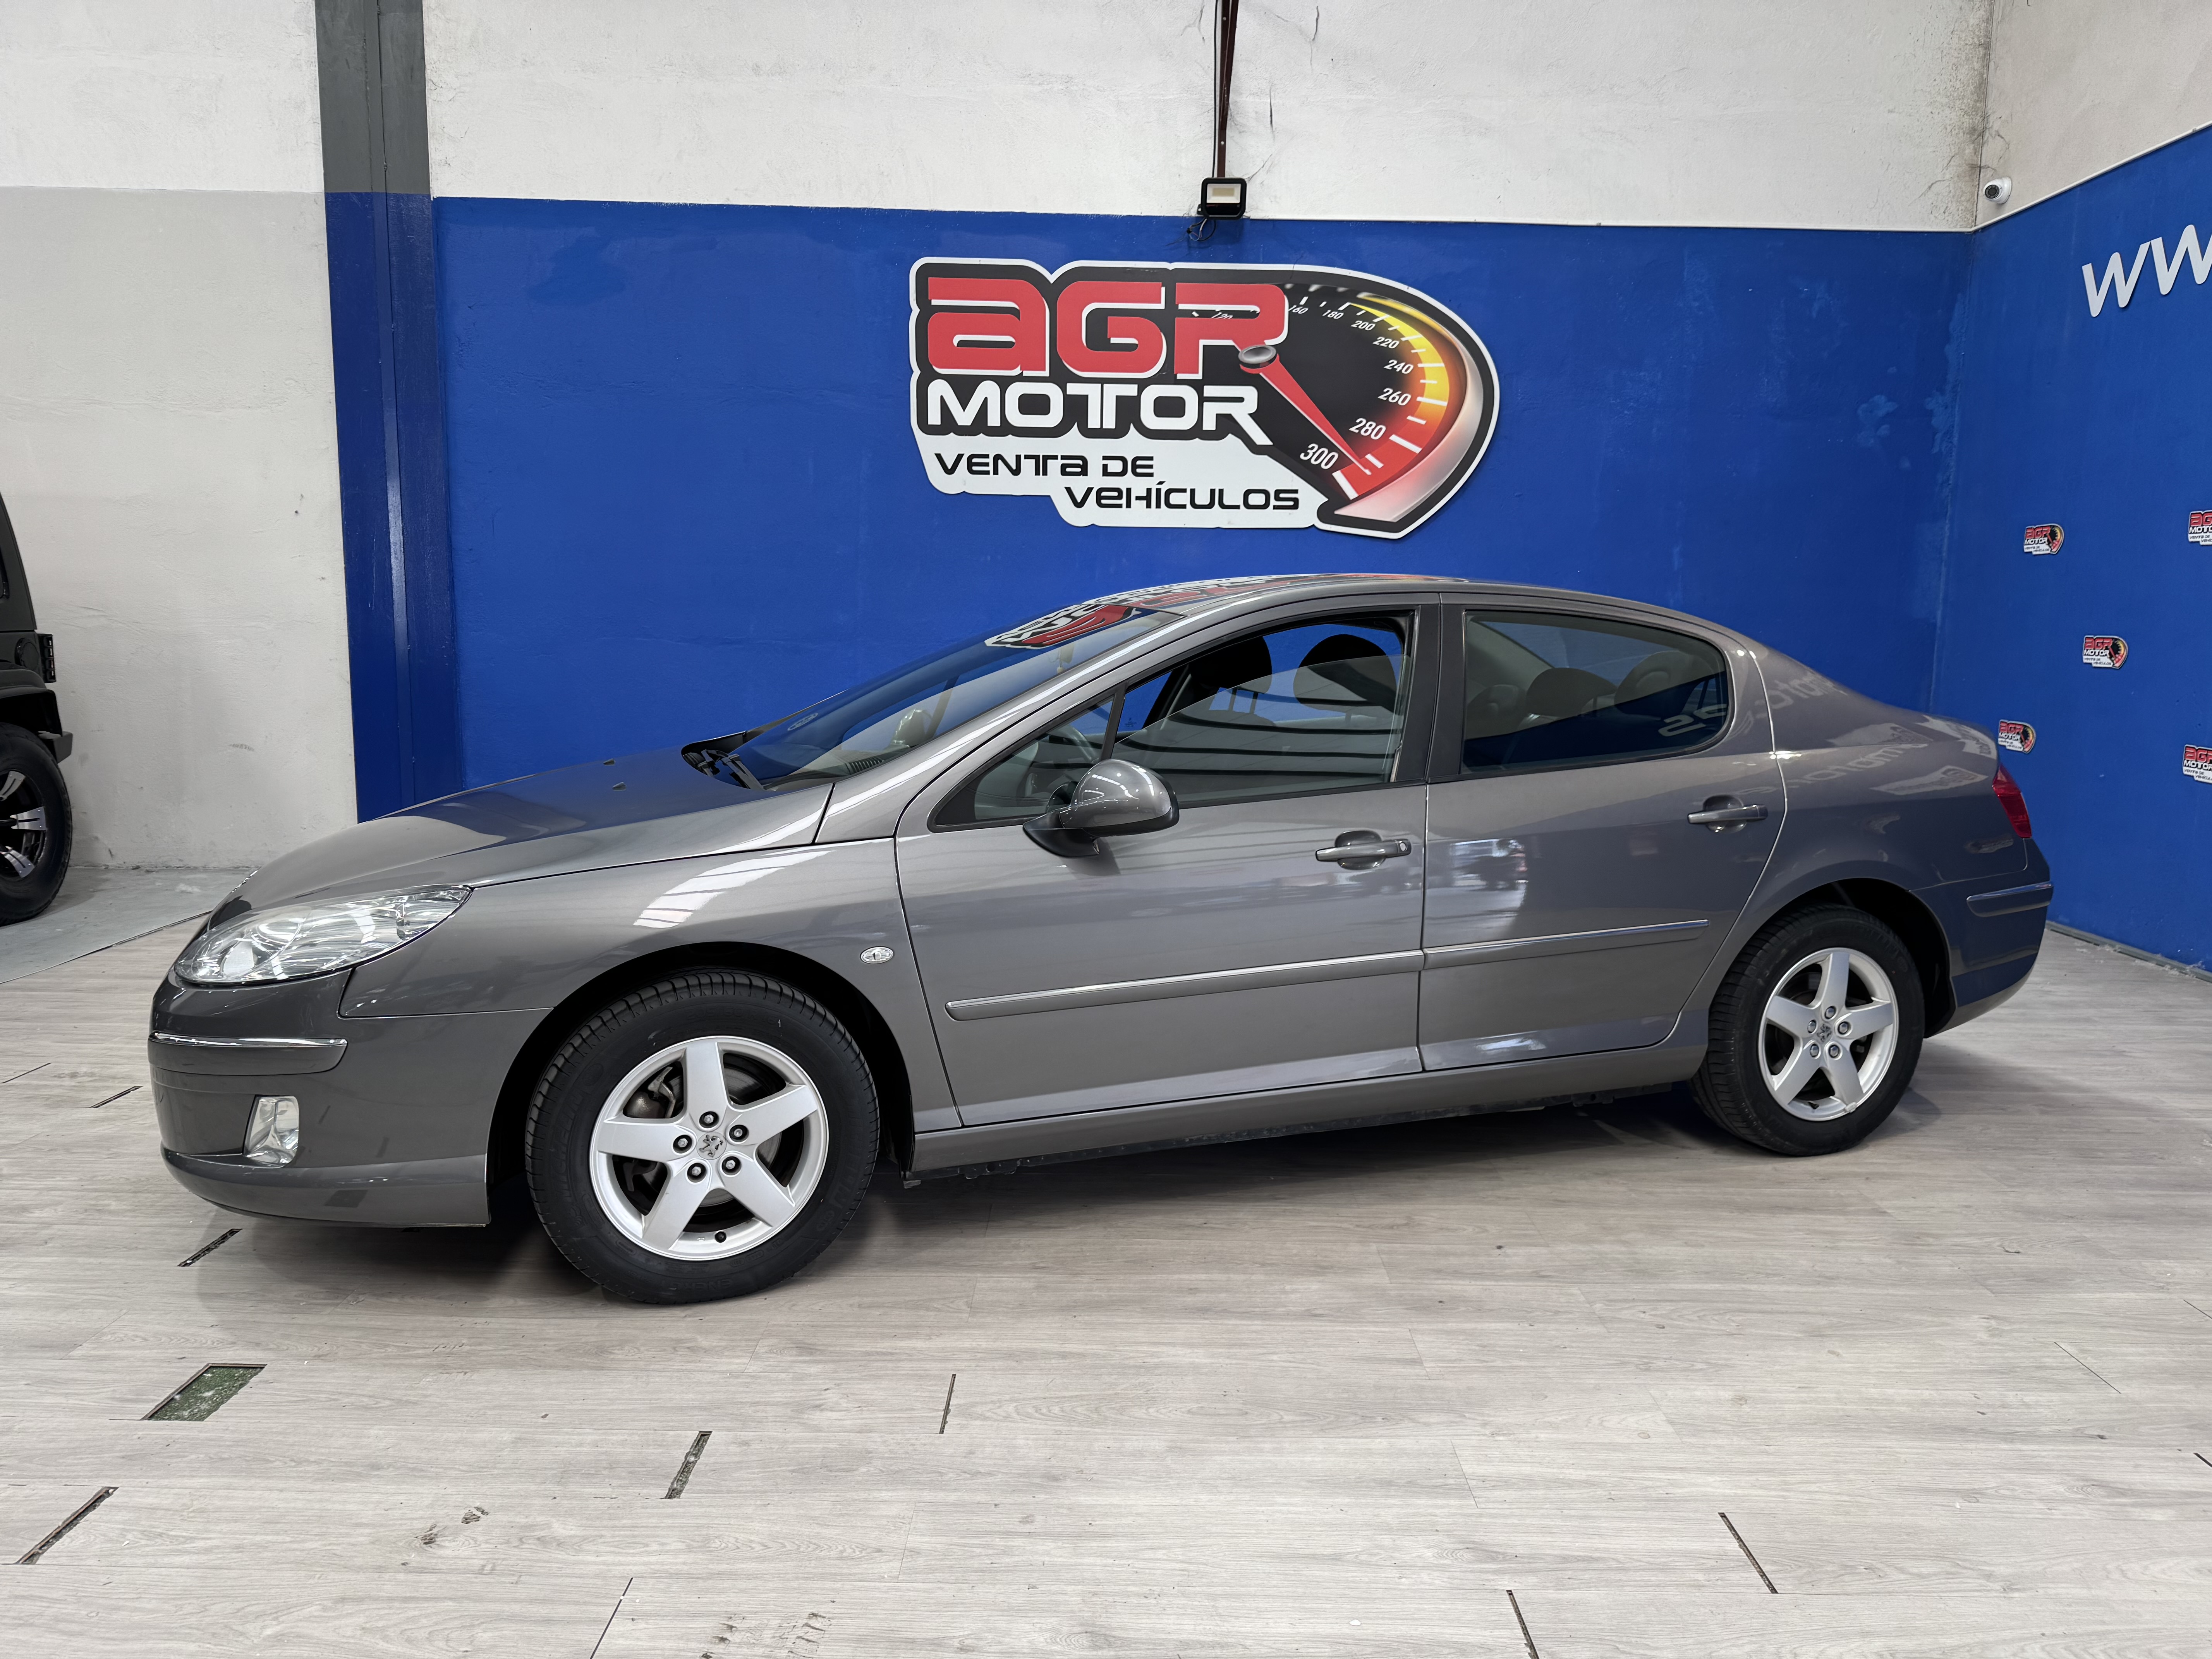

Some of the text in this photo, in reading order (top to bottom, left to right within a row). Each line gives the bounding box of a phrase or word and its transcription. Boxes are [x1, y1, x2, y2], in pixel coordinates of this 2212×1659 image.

[1322, 310, 1344, 319] 180
[1351, 320, 1376, 331] 200
[1372, 337, 1400, 349] 220
[1384, 359, 1414, 374] 240
[1377, 388, 1412, 406] 260
[928, 379, 1273, 445] MOTOR
[1349, 417, 1386, 440] 280
[1300, 443, 1339, 470] 300
[1102, 455, 1154, 477] DE
[2083, 649, 2110, 658] MOTOR
